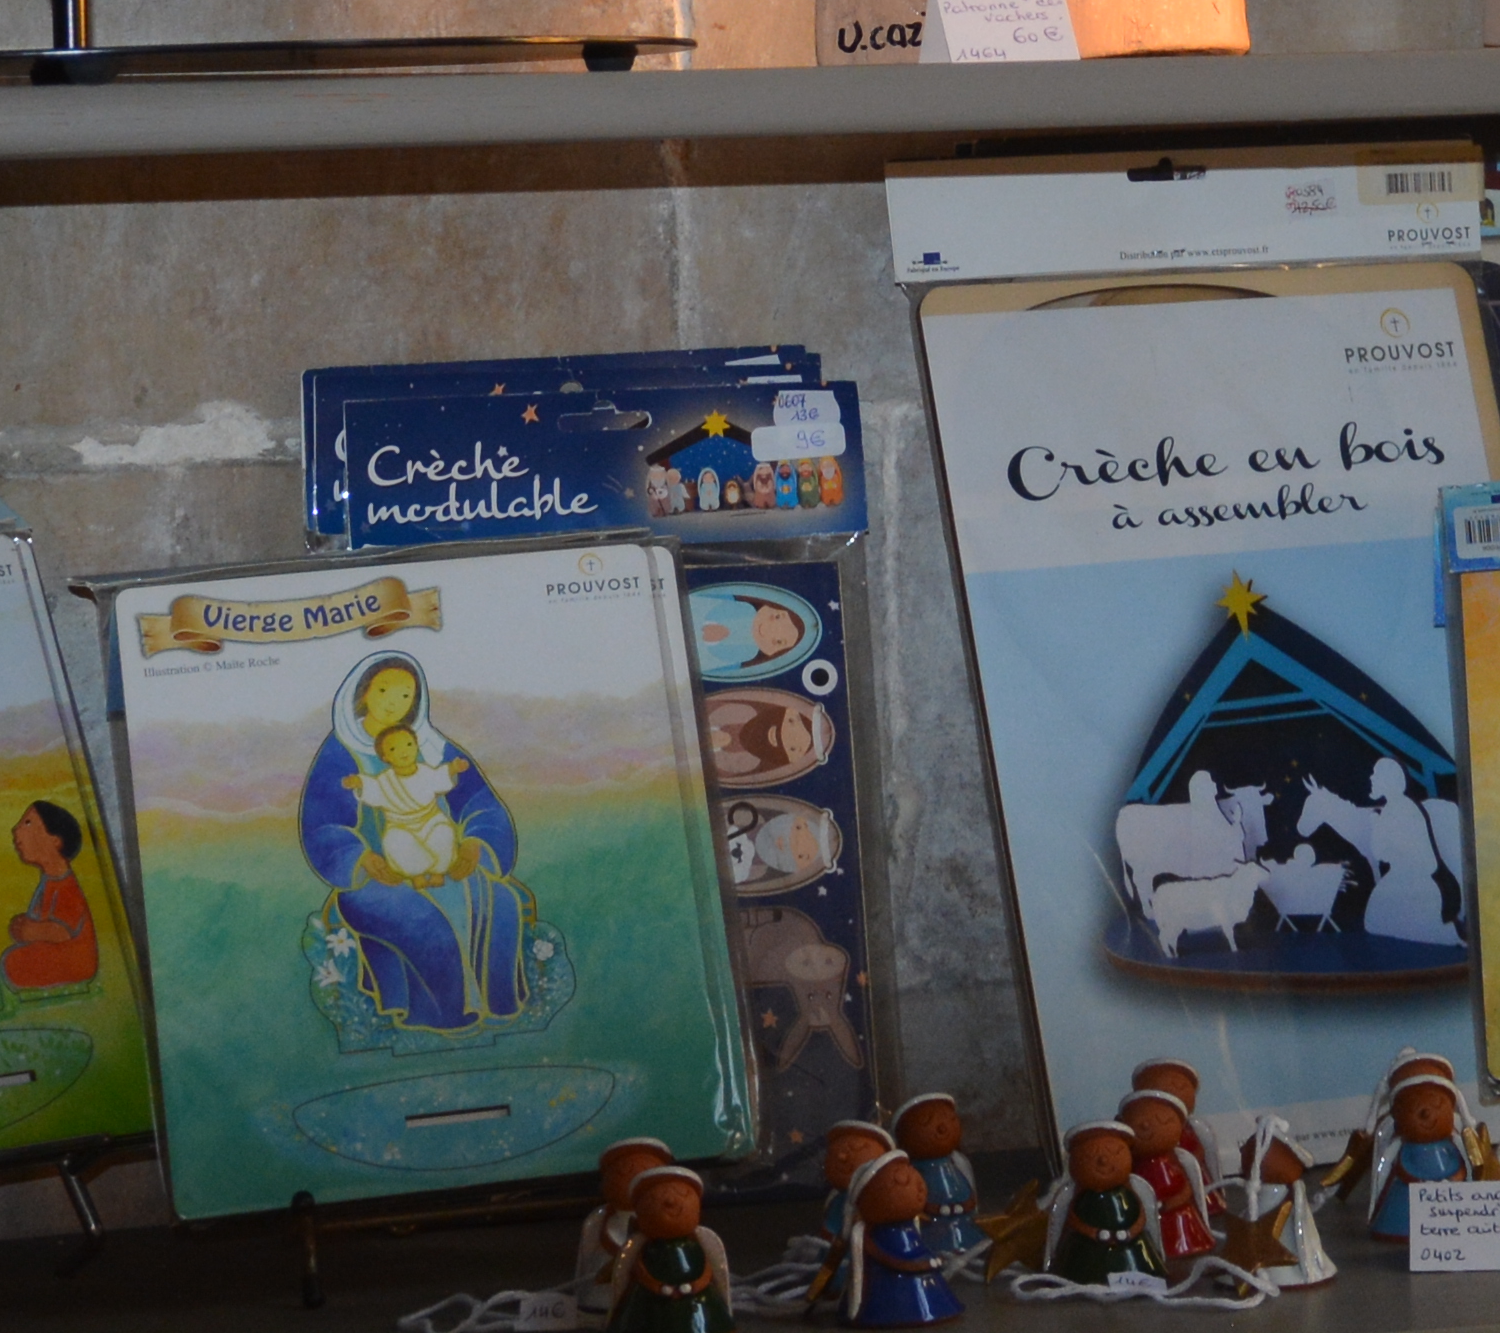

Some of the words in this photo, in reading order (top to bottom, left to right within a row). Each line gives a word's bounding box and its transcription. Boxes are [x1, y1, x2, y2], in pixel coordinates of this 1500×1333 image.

[955, 47, 1008, 63] 1464
[1387, 226, 1471, 243] PROUVOST
[1344, 341, 1454, 364] PROUVOST
[367, 440, 531, 488] Crèche
[1007, 436, 1228, 502] Crèche
[1248, 445, 1320, 474] en
[1339, 421, 1445, 473] bois
[367, 473, 599, 525] modulable
[1111, 502, 1143, 530] à
[1157, 482, 1368, 528] assembler
[546, 576, 639, 596] PROUVOST
[203, 603, 294, 633] Vierge
[303, 594, 381, 629] Marie
[143, 664, 200, 678] Illustration
[248, 655, 280, 669] Roche
[1419, 1187, 1463, 1203] Petits
[1420, 1223, 1462, 1236] terre
[1420, 1247, 1467, 1261] 0402
